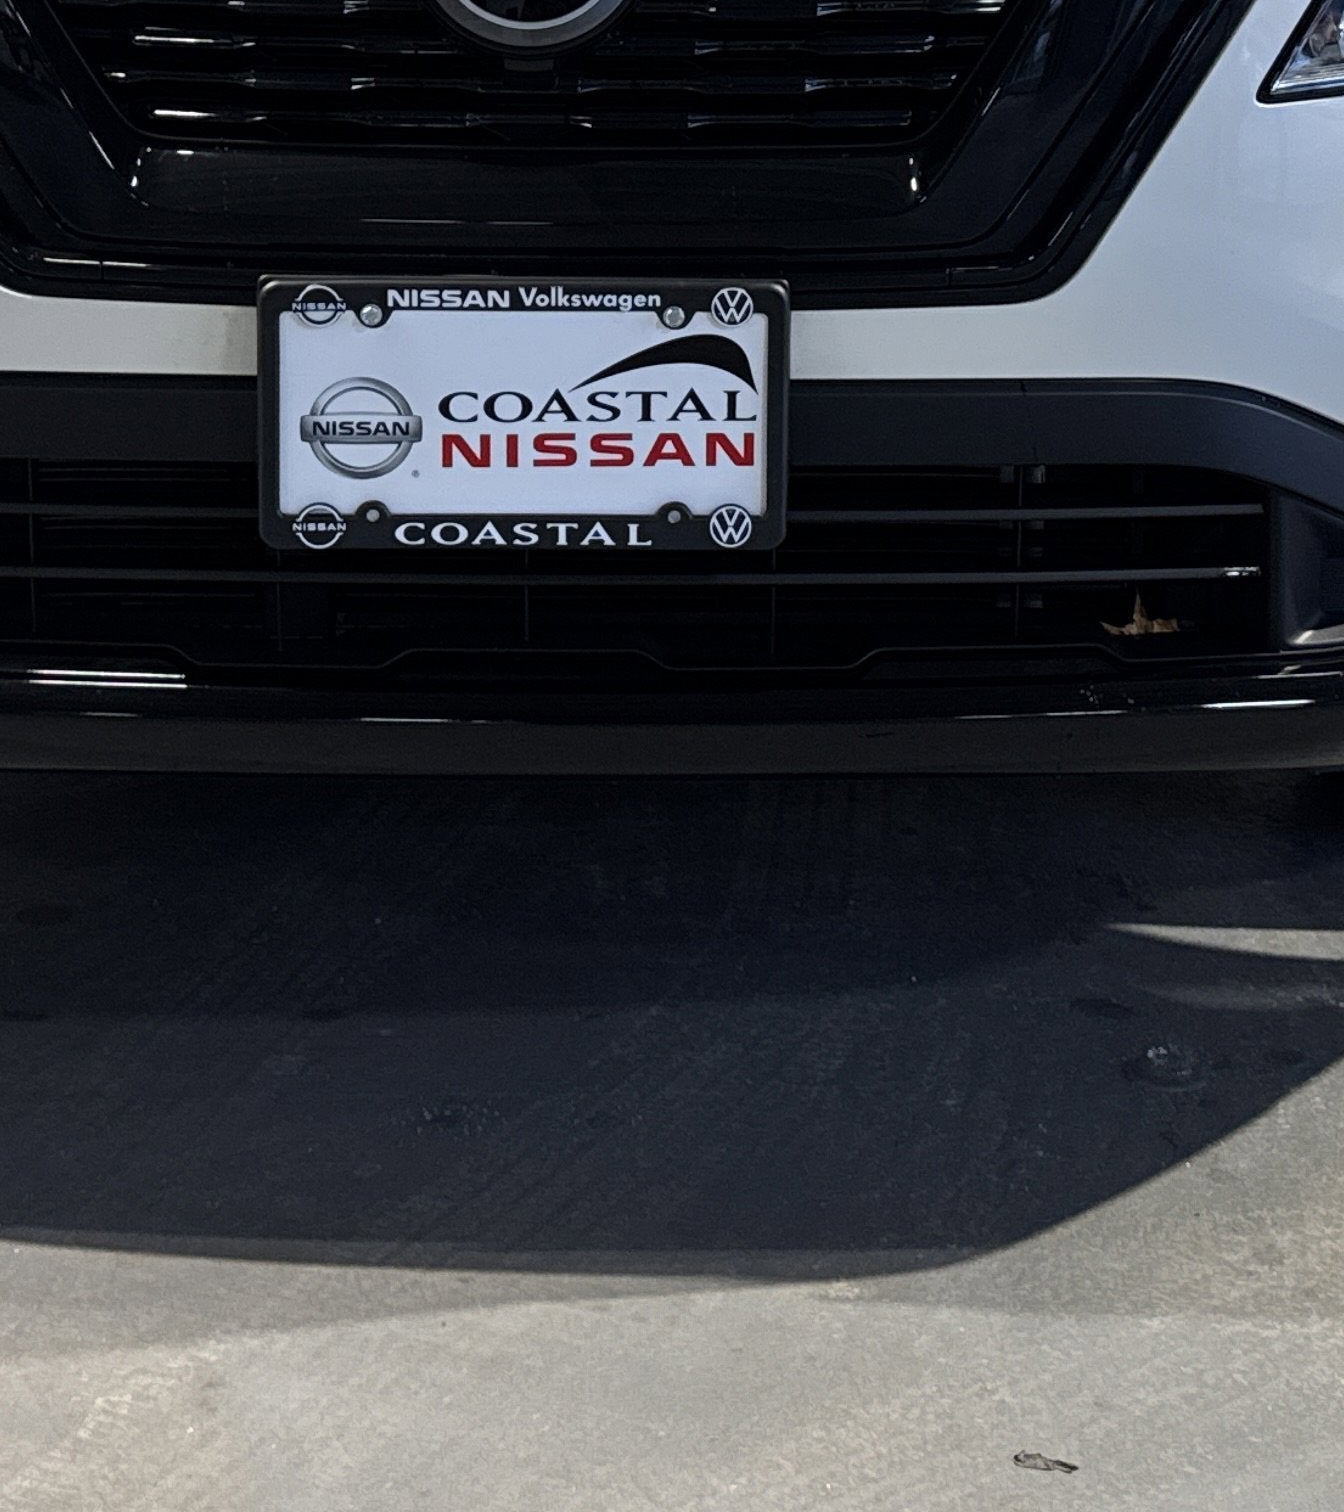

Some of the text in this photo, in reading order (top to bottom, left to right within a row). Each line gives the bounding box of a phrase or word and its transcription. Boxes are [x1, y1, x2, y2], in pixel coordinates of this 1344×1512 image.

[292, 302, 347, 311] NISSAN
[387, 285, 662, 312] NISSAN Volkswagen
[437, 388, 757, 423] COASTAL
[311, 420, 411, 438] NISSAN
[441, 432, 755, 468] NISSAN
[292, 522, 347, 532] NISSAN
[394, 521, 653, 547] COASTAL
